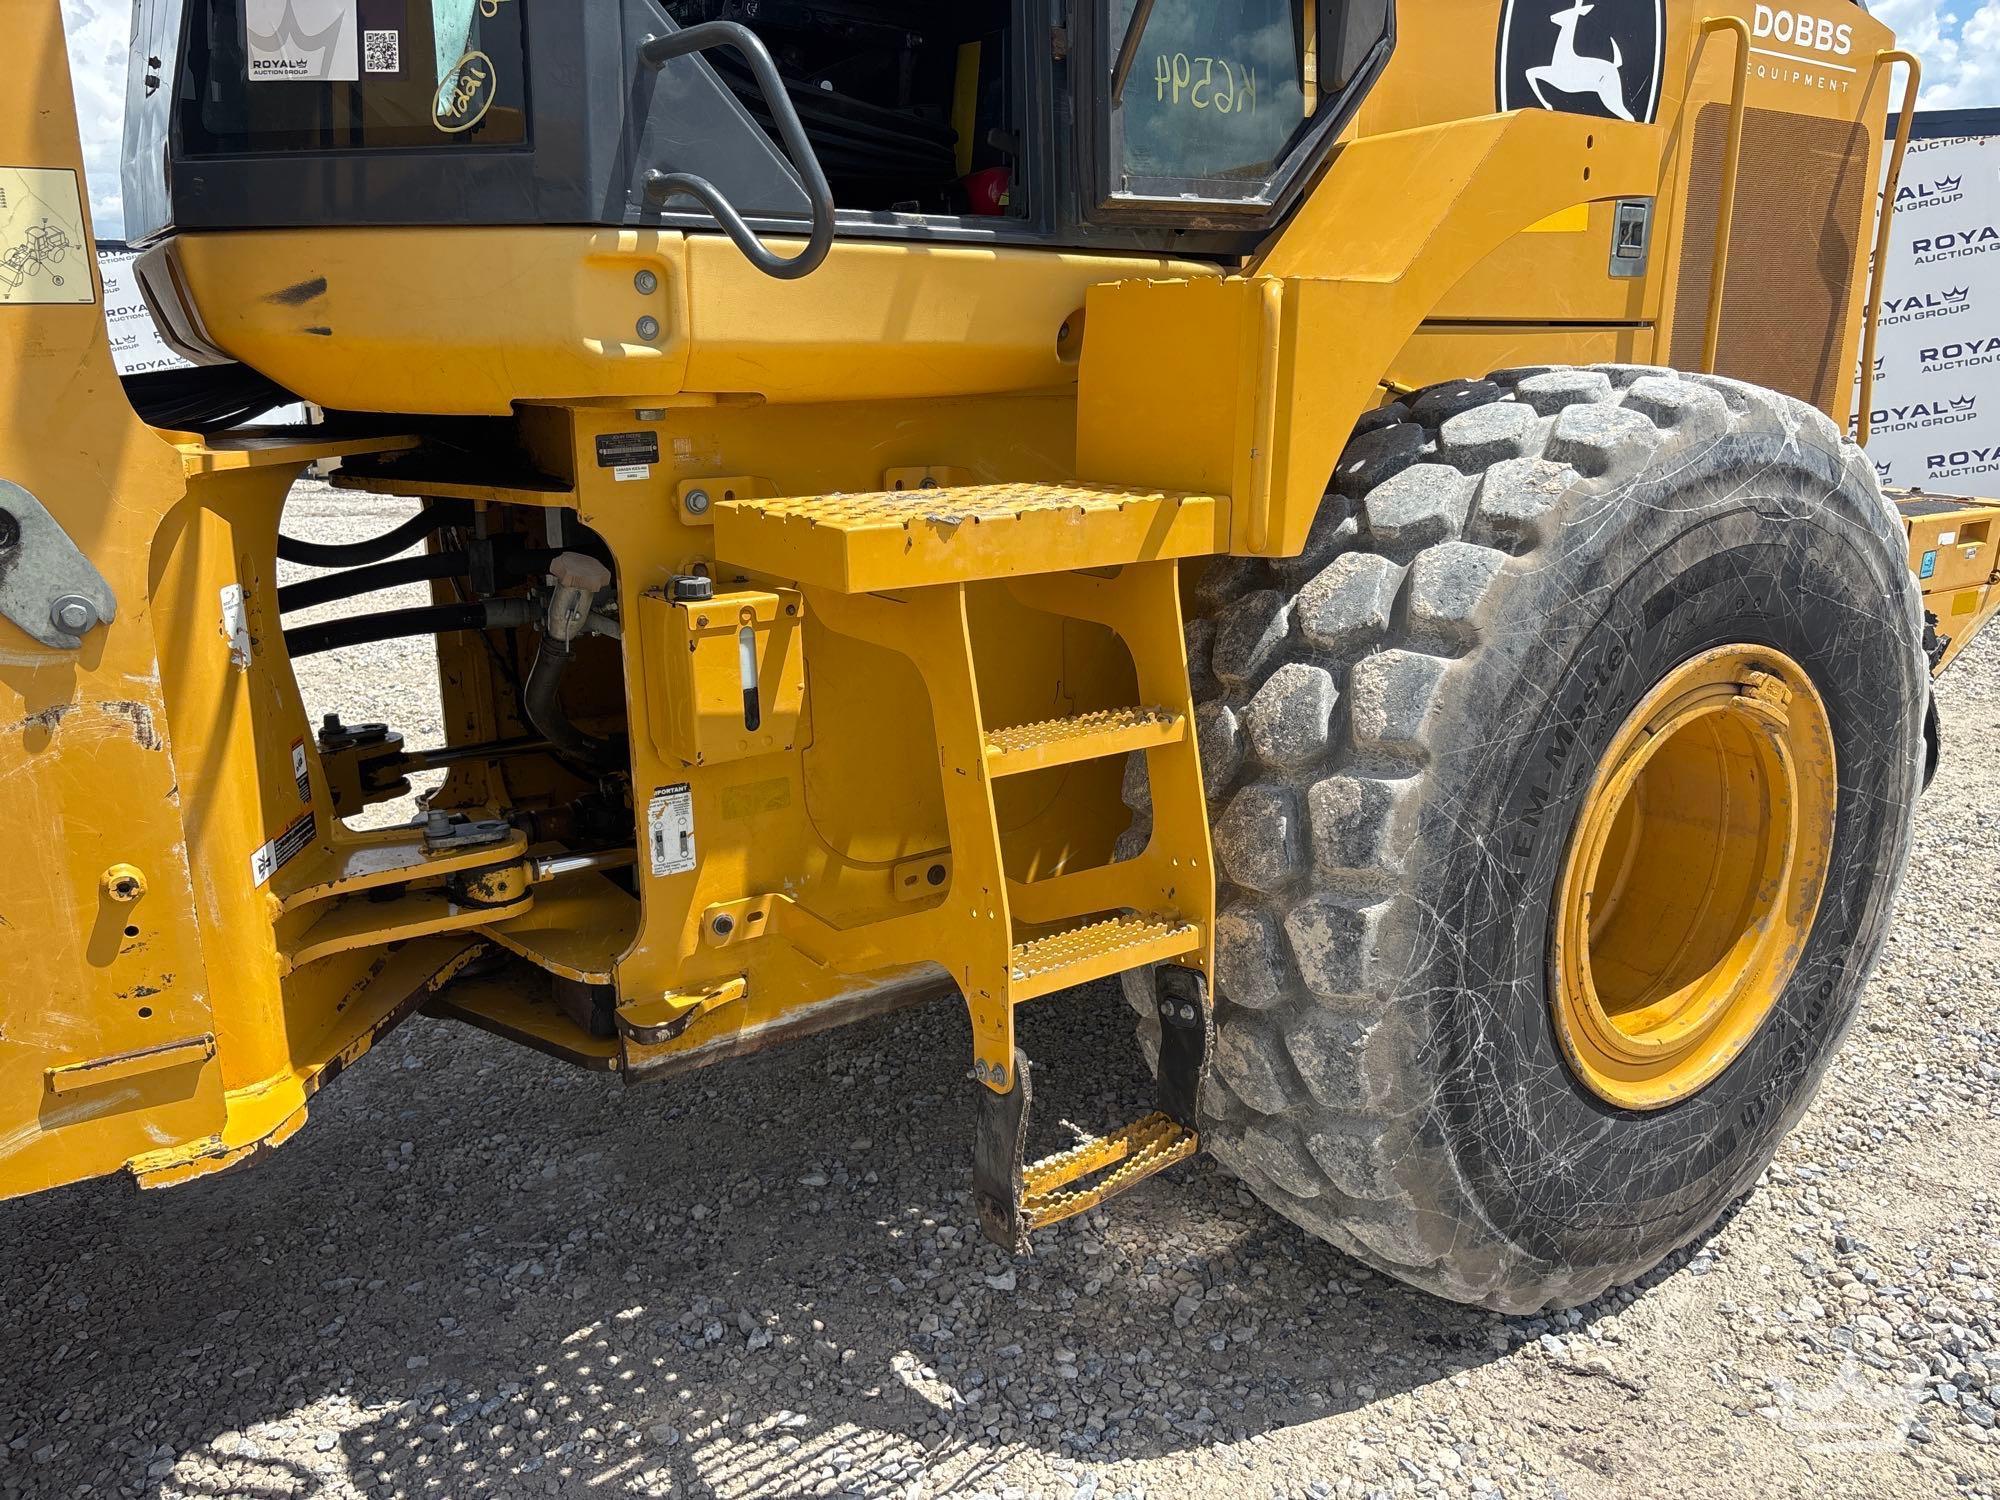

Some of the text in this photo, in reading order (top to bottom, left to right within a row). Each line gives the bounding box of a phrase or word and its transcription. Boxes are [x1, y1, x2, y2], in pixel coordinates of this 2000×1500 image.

[1752, 3, 1853, 56] DOBBS
[253, 60, 297, 69] ROYAL
[1746, 62, 1849, 93] EQUIPMENT
[1906, 136, 1979, 154] AUCTION
[1907, 193, 1963, 211] GROUP
[1914, 245, 1986, 266] AUCTION
[1914, 304, 1971, 321] GROUP
[125, 358, 176, 373] ROYAL
[1921, 355, 1993, 374] AUCTION
[1850, 412, 1978, 438] ACTION GROUP
[1928, 463, 2000, 479] AUCTION
[1510, 626, 1634, 858] EM-Master
